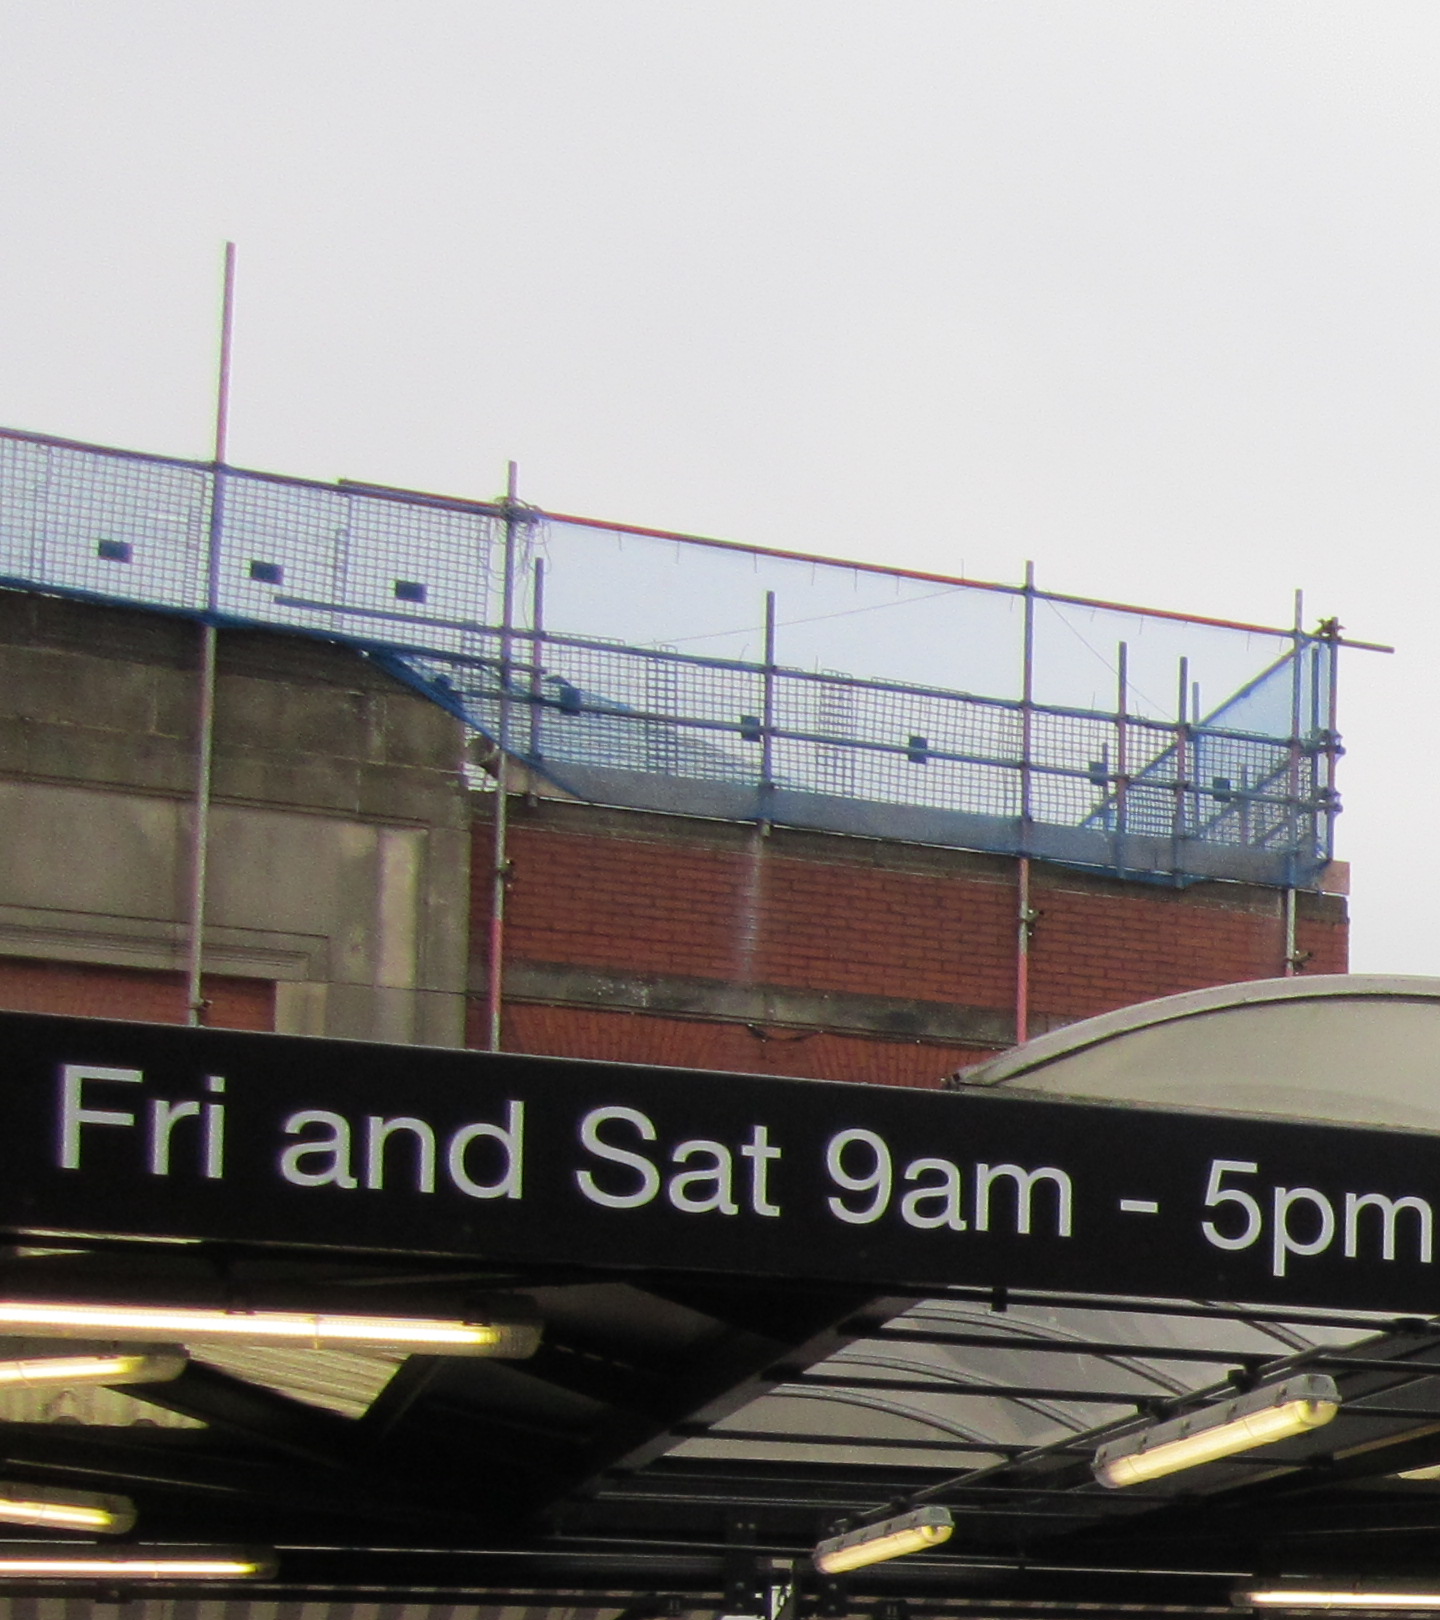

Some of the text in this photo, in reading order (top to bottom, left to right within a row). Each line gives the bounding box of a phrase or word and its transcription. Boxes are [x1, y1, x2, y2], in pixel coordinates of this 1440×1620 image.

[61, 1064, 1433, 1277] Fri and Sat 9am - 5pm
